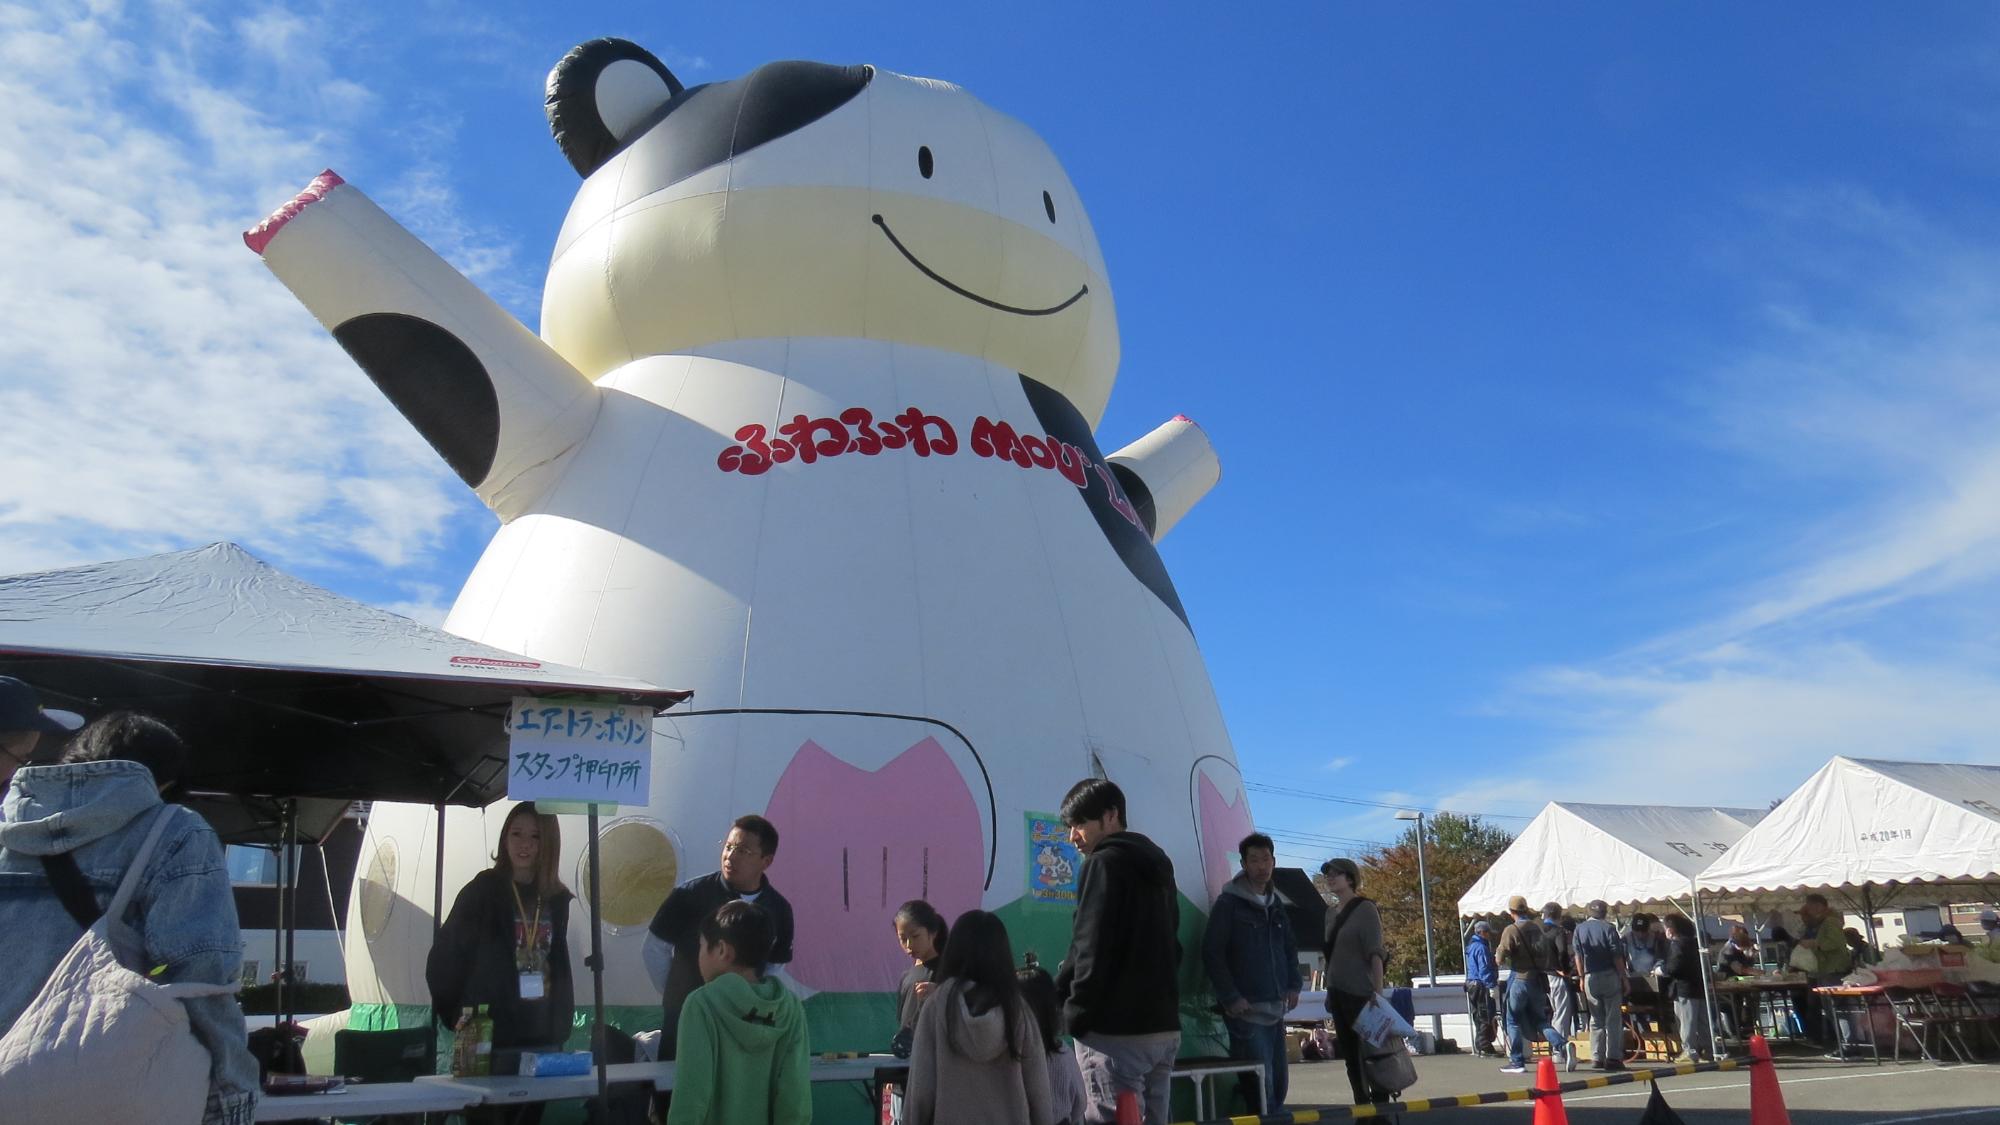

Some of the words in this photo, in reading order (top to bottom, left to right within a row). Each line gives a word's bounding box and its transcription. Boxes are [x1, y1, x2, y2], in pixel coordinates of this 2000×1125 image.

[718, 408, 958, 475] ふわふわ
[457, 656, 522, 667] Coleman
[516, 707, 647, 745] エアートランポリン
[514, 752, 642, 792] スタンプ押印所
